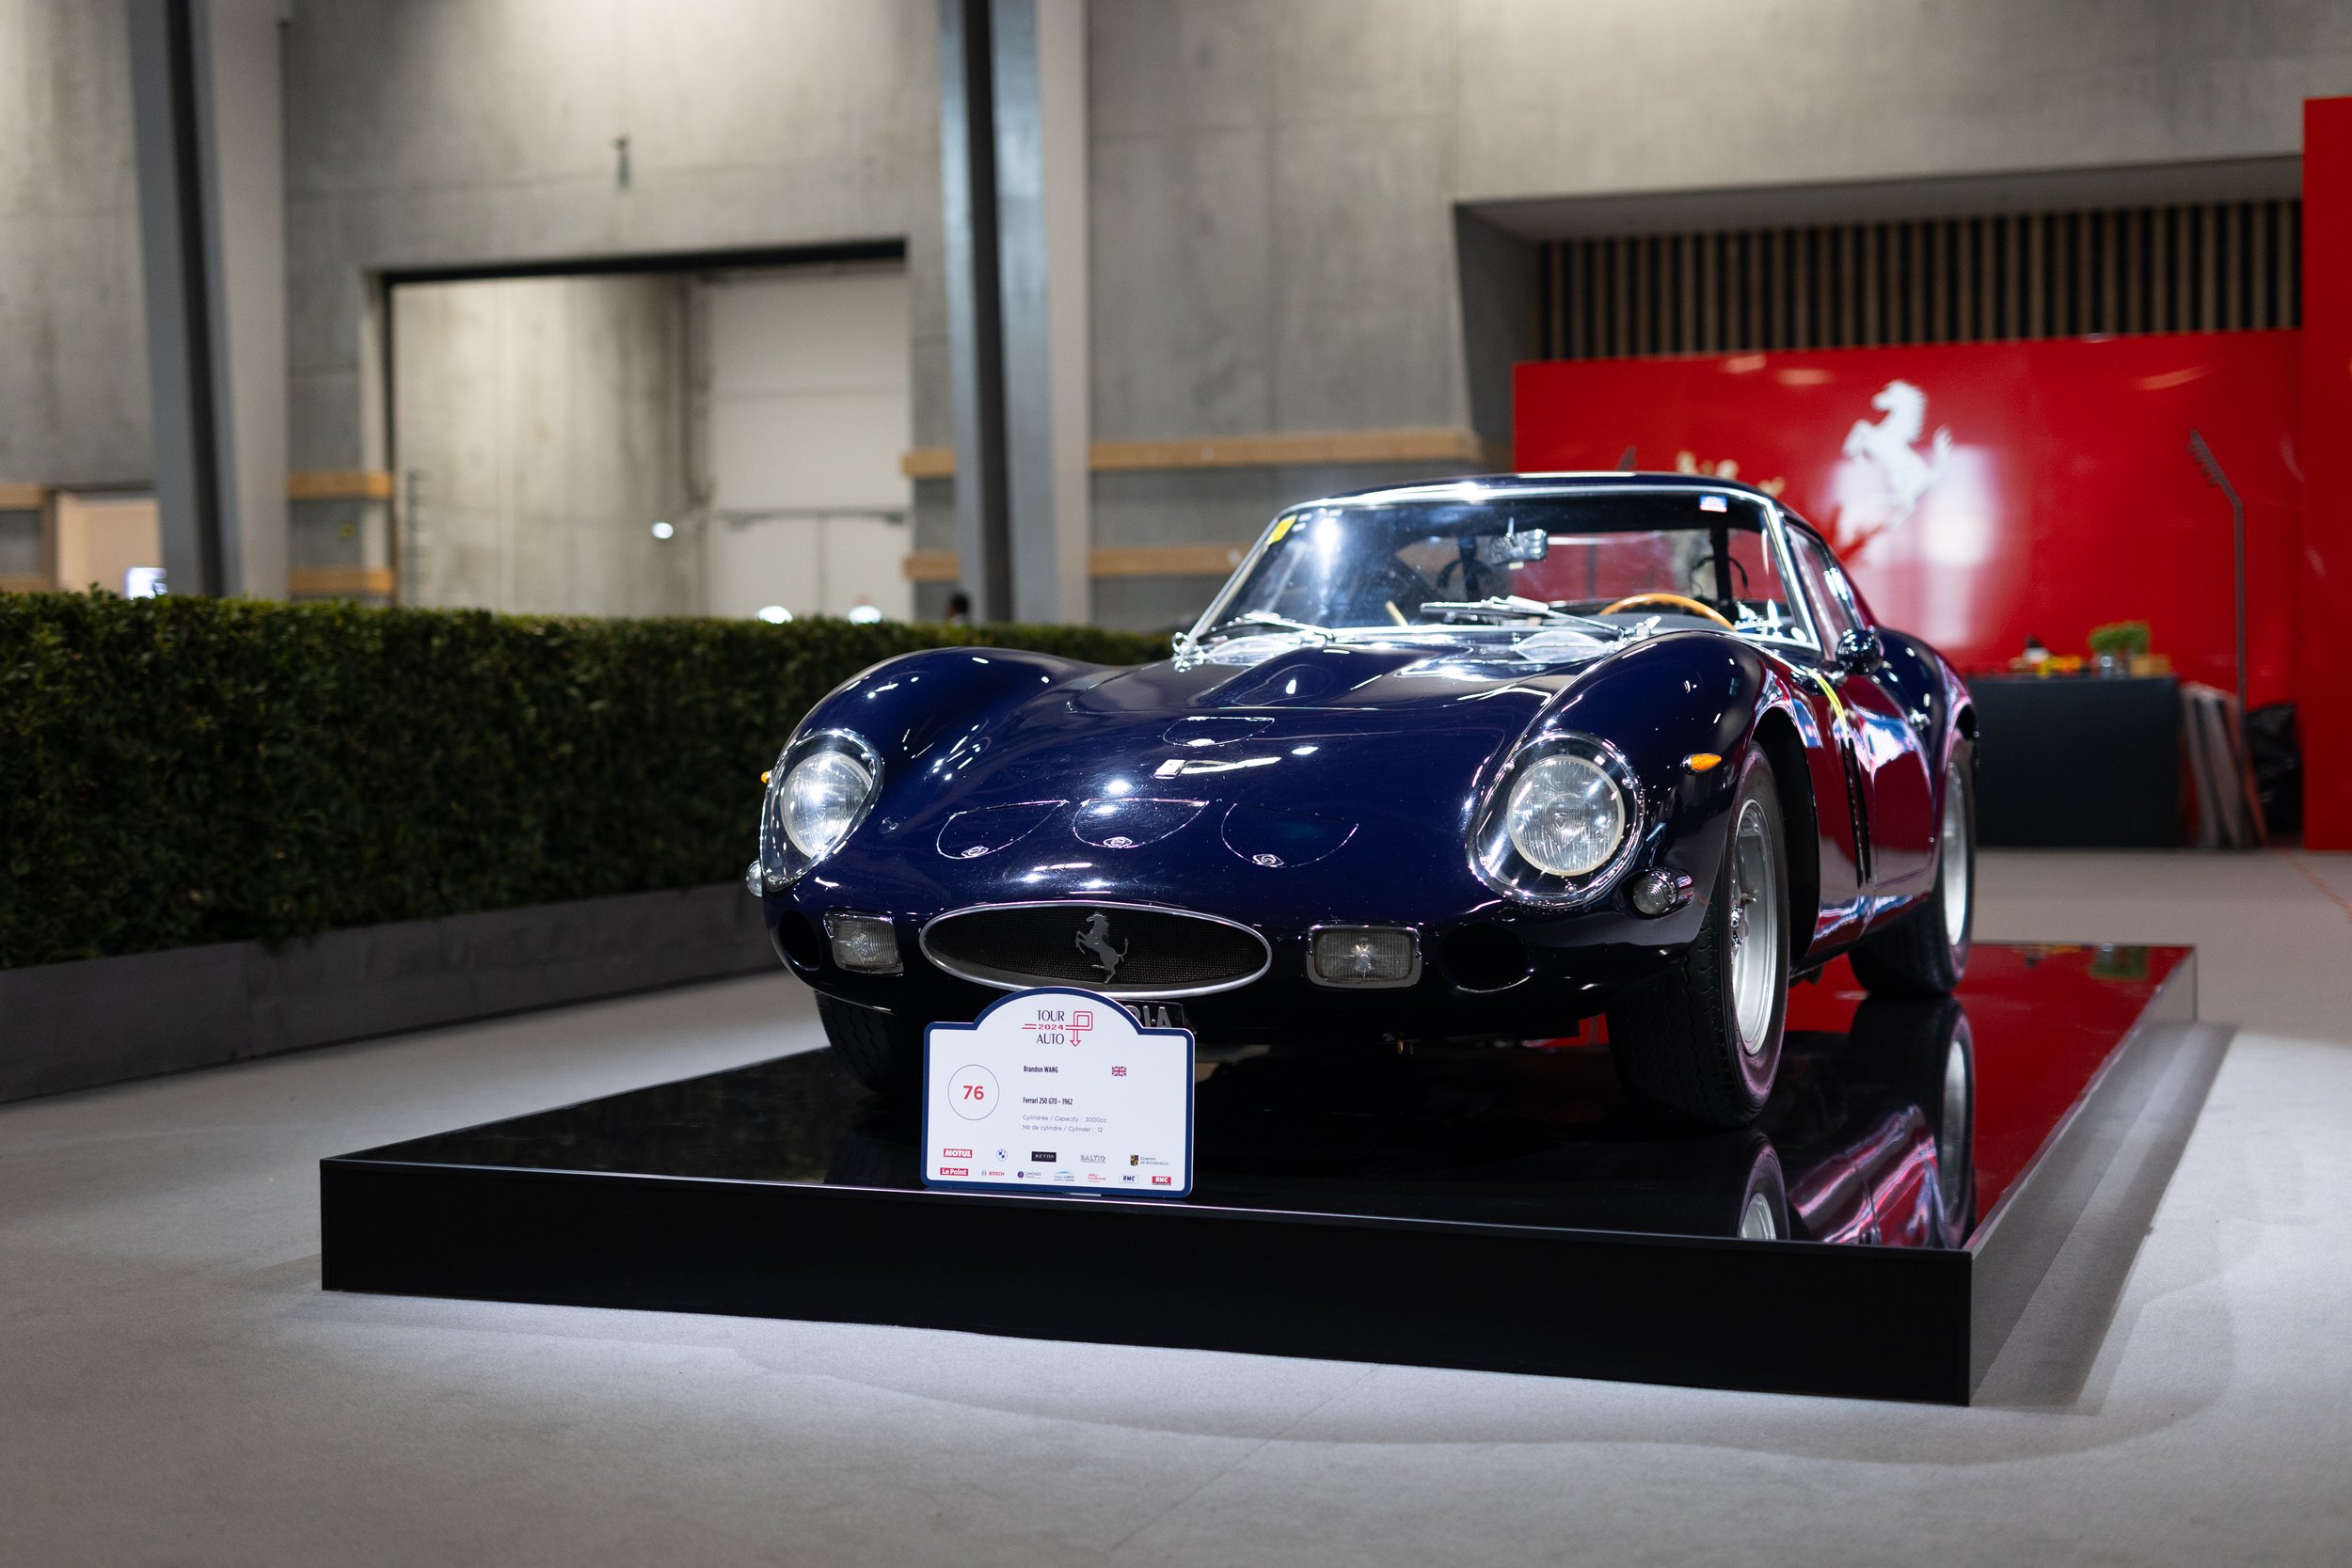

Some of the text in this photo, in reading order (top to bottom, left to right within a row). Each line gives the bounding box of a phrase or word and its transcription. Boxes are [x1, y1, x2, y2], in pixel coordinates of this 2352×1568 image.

[1037, 1010, 1065, 1022] TOUR
[1036, 1033, 1065, 1045] AUTO
[1024, 1065, 1043, 1073] Brandon
[962, 1085, 984, 1101] 76
[1039, 1097, 1048, 1105] 250
